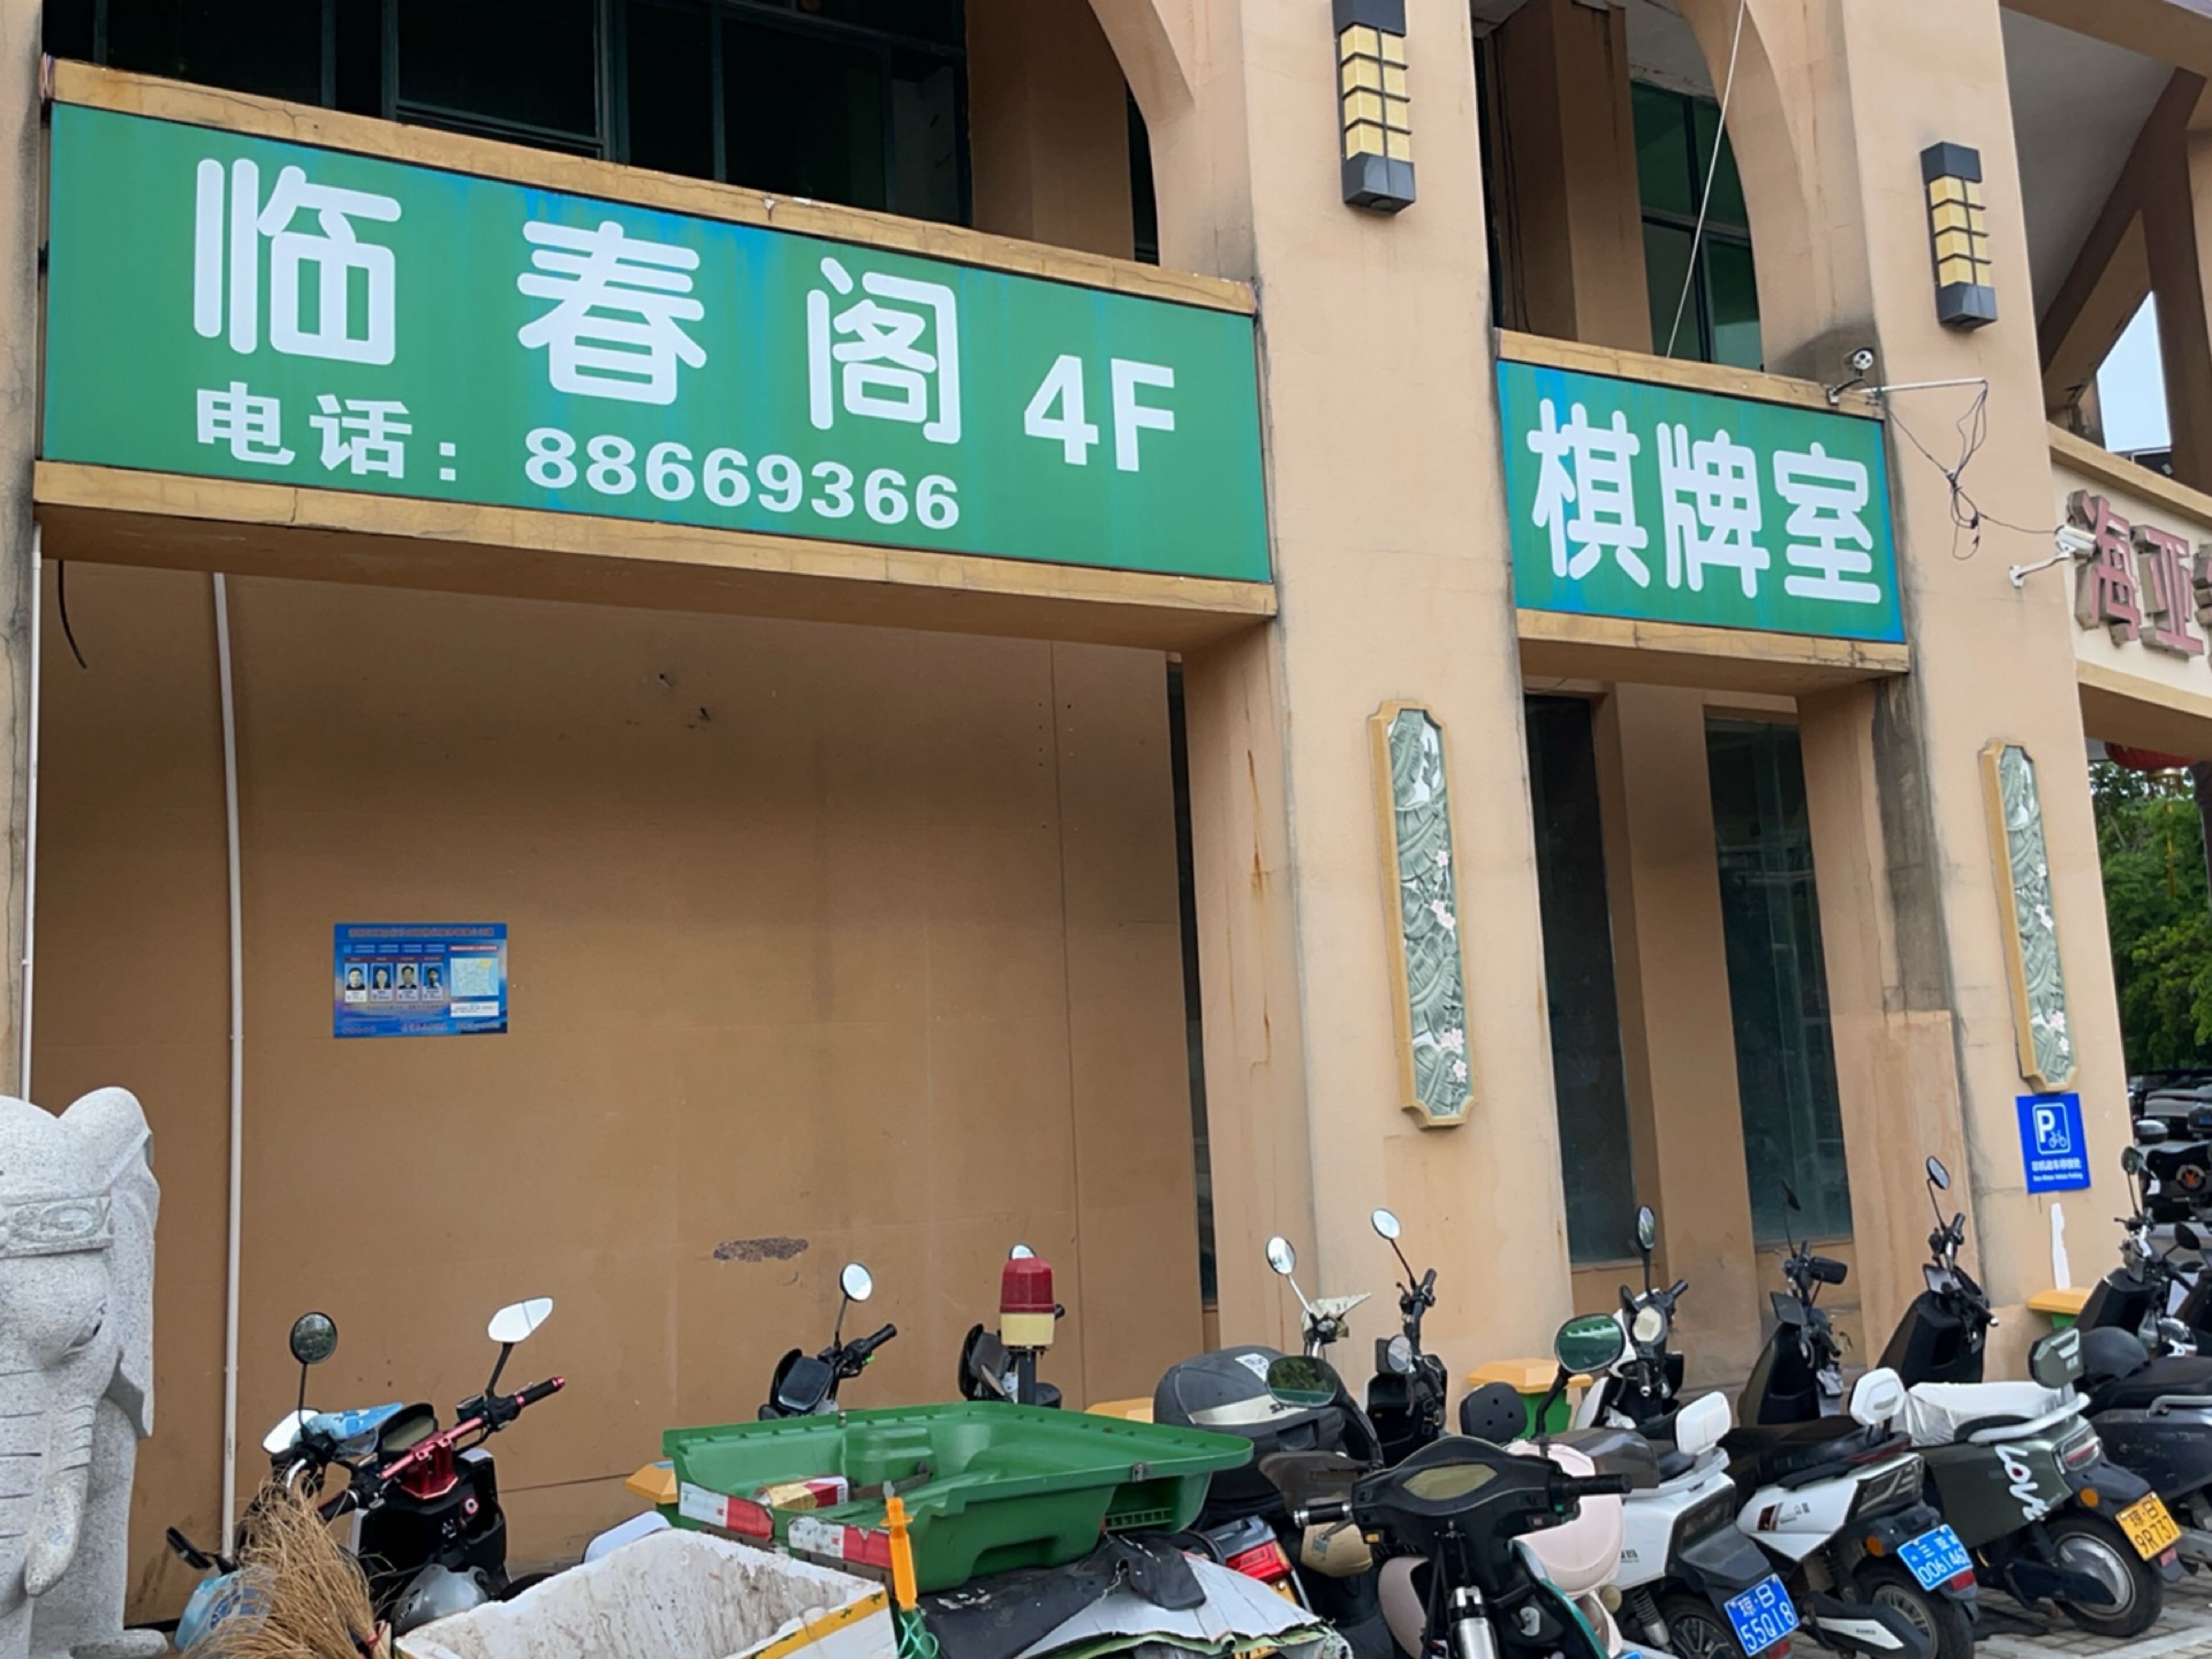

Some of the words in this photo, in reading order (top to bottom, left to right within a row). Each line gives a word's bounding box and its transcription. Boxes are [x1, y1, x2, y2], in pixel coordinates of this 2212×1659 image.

[194, 158, 961, 444] 临春阁
[1024, 355, 1174, 471] 4F
[525, 428, 959, 529] 88669366
[1527, 399, 1880, 603] 棋牌室
[2067, 489, 2212, 669] 海亚
[2037, 1110, 2055, 1142] P
